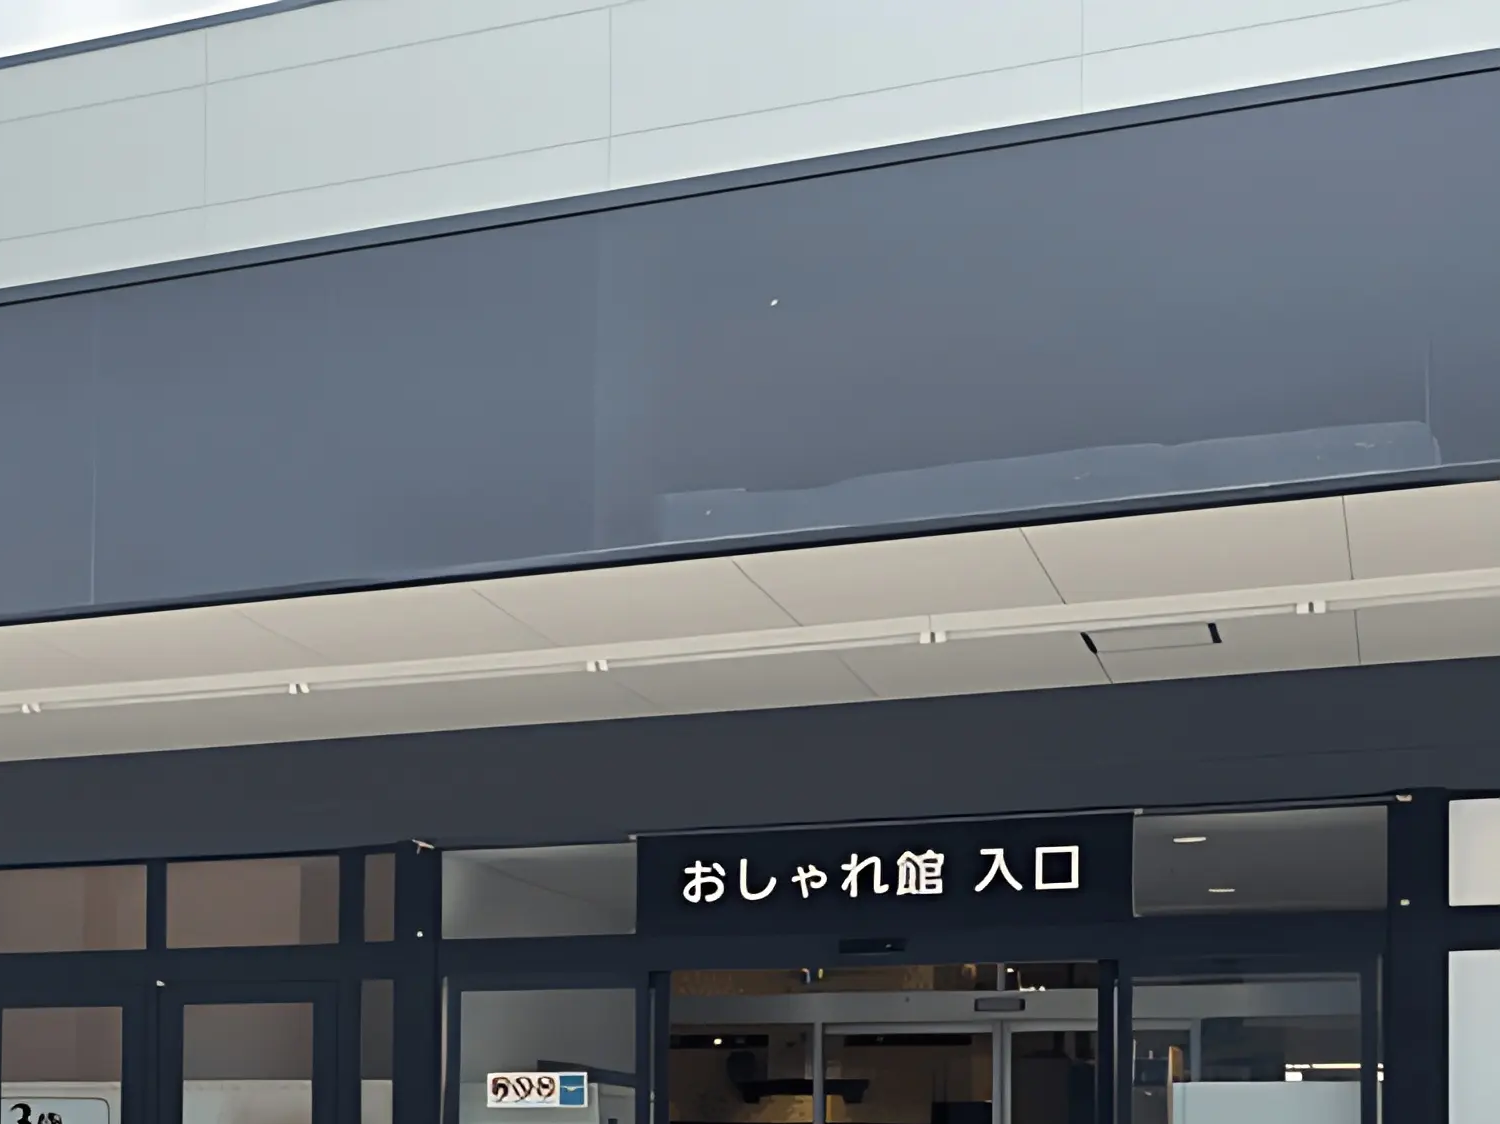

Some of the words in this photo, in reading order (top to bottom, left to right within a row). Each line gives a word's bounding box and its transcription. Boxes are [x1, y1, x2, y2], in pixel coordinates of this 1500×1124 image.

[682, 849, 945, 903] おしゃれ館
[974, 845, 1080, 892] 入口
